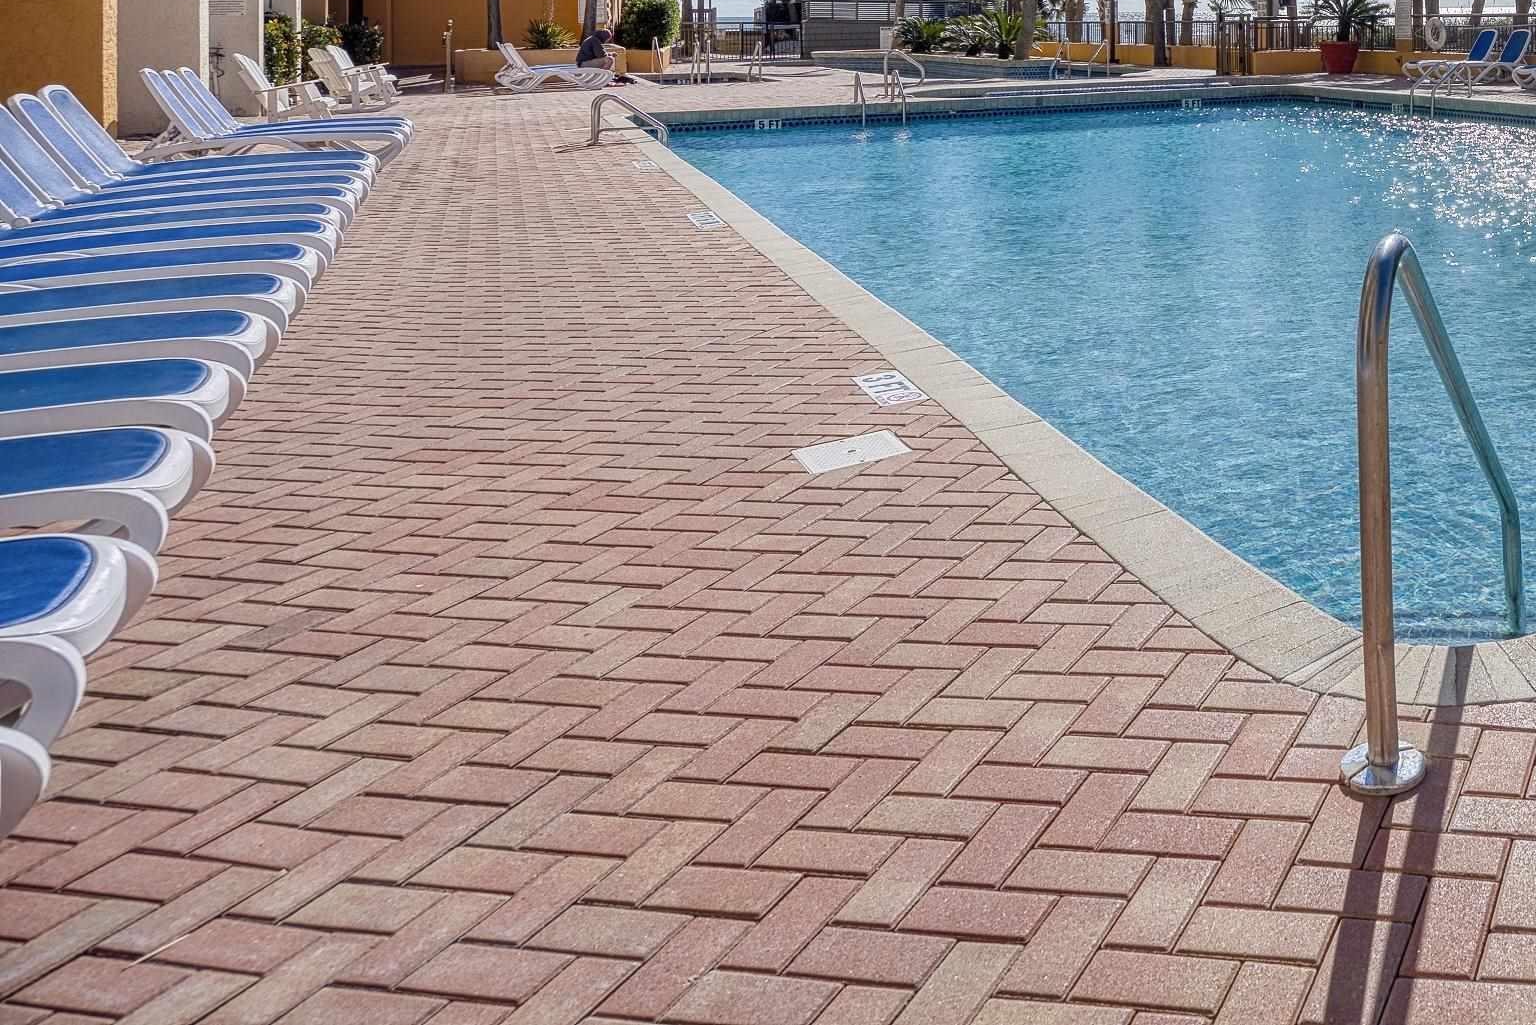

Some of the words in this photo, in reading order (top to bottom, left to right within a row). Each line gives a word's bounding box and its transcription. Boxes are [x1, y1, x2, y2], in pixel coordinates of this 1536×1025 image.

[758, 120, 765, 129] 5
[768, 119, 780, 129] FT
[867, 381, 911, 394] FT
